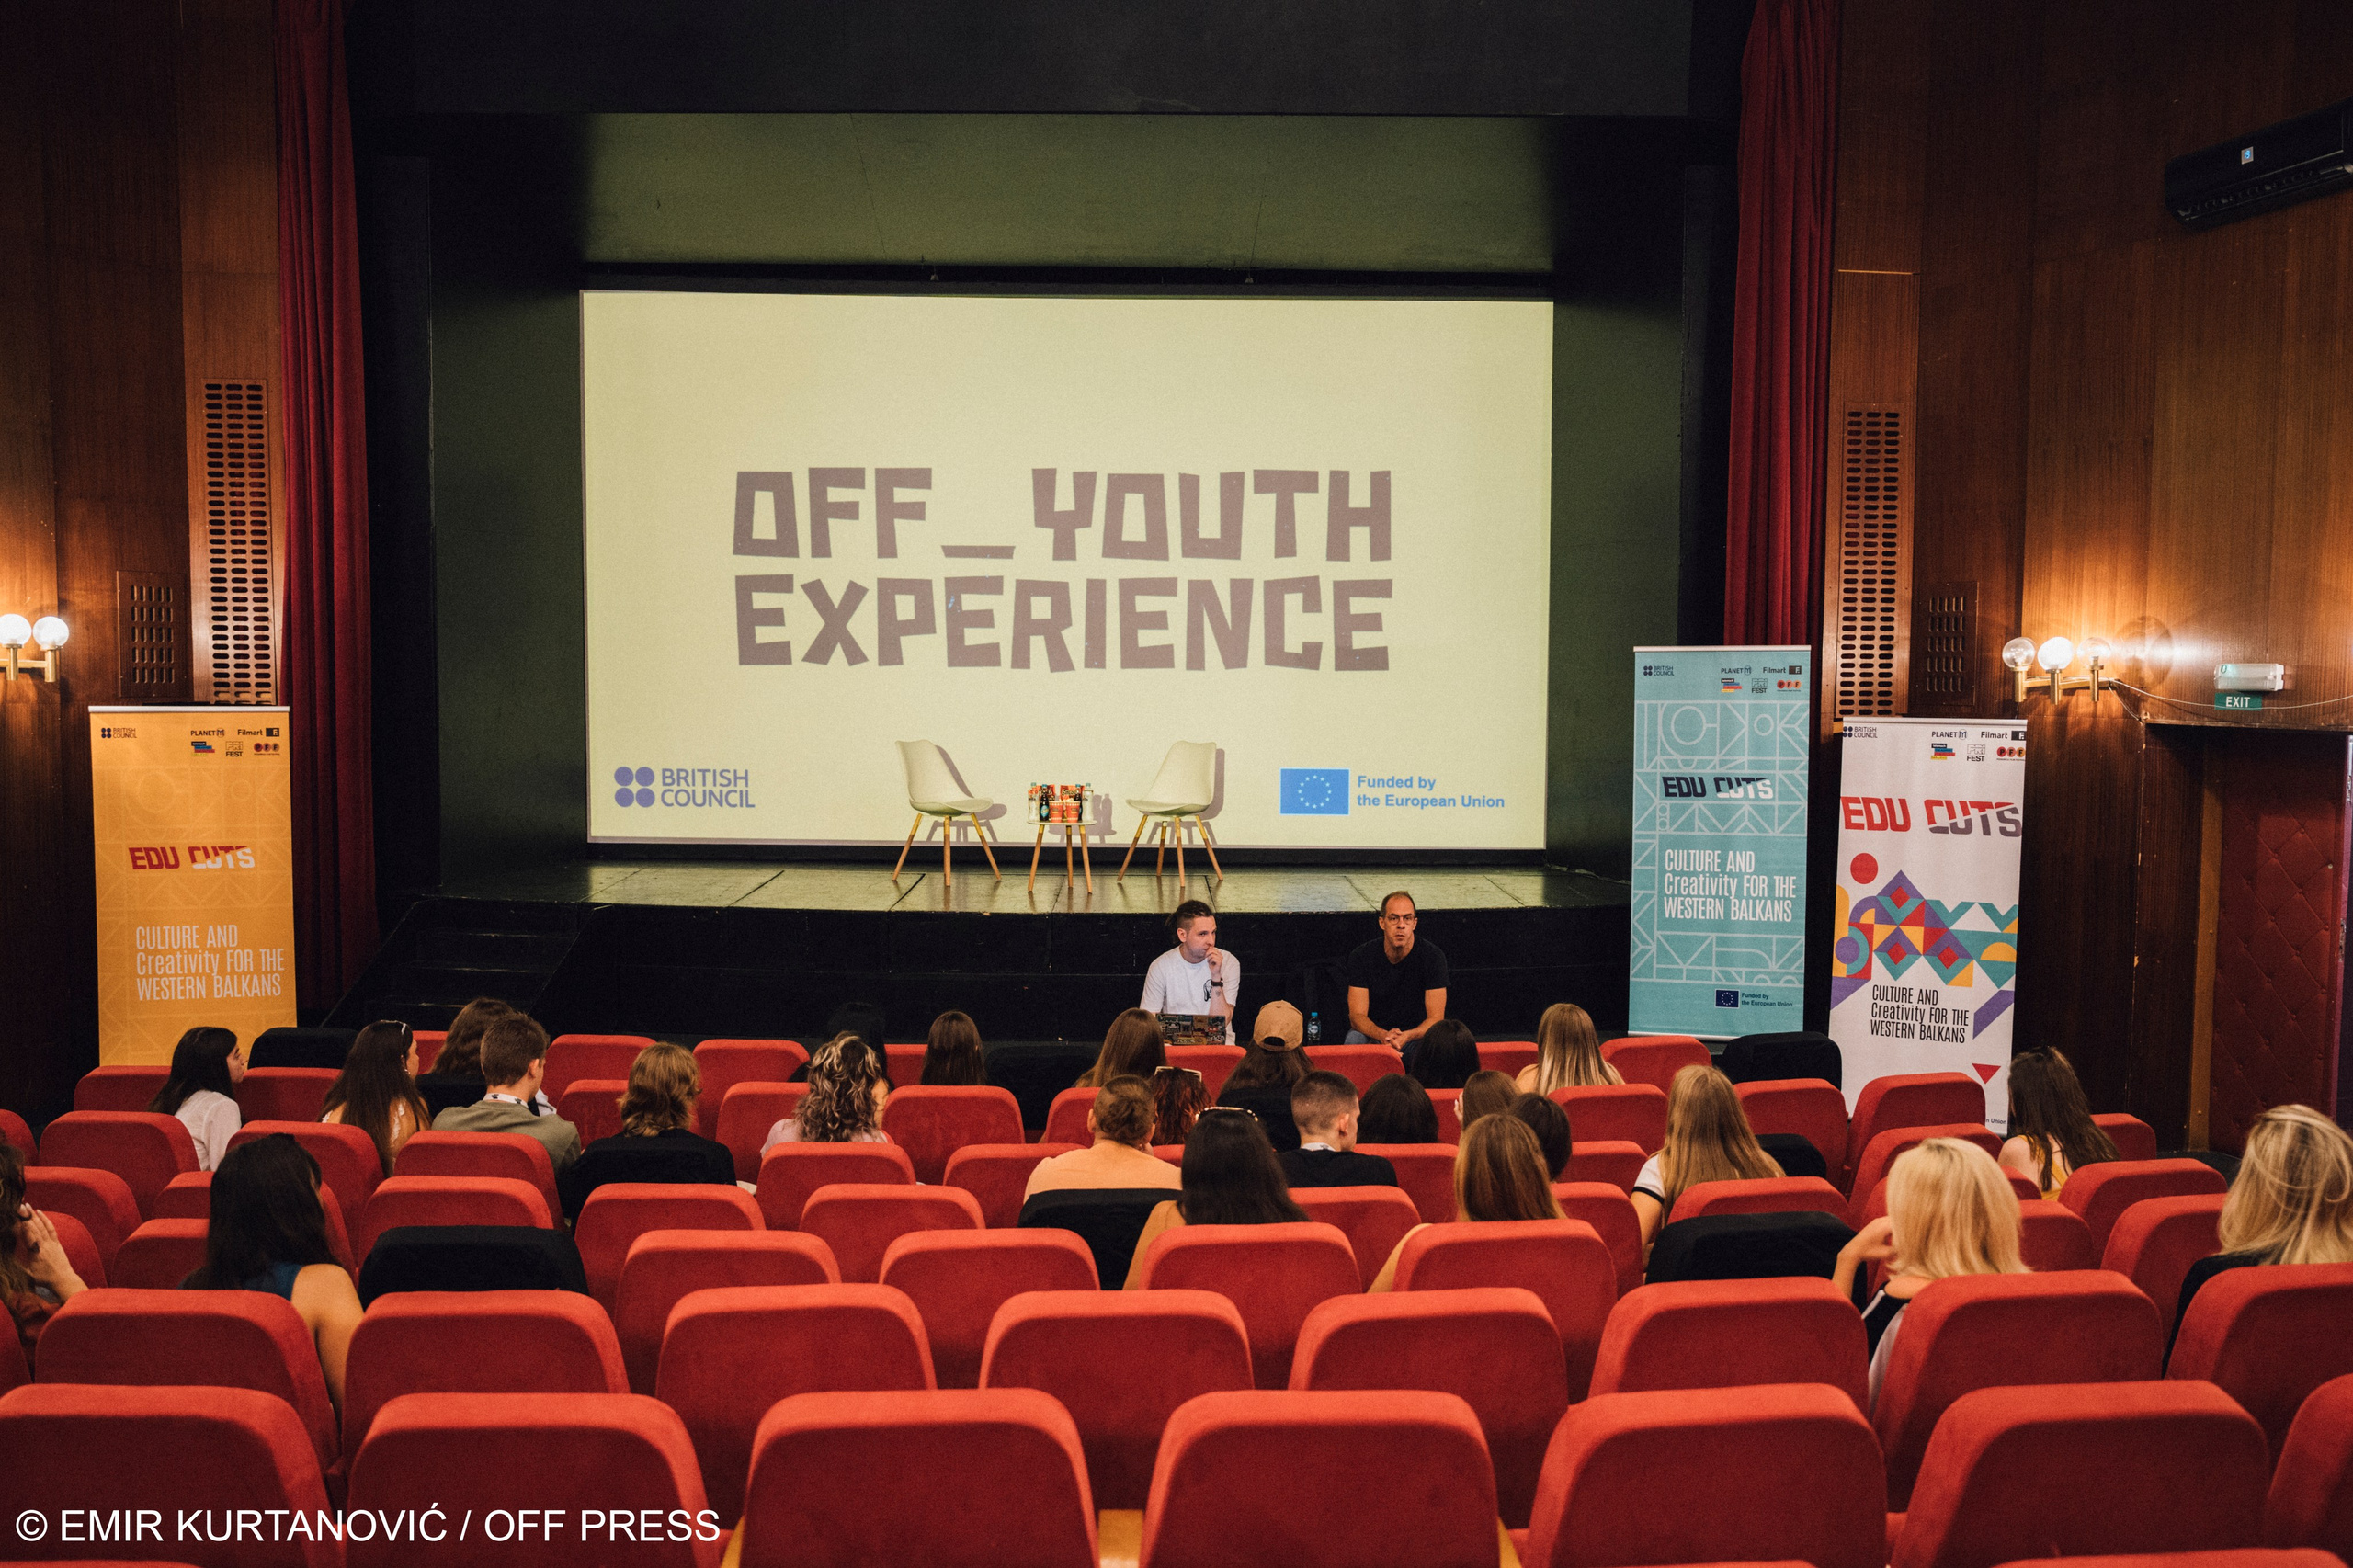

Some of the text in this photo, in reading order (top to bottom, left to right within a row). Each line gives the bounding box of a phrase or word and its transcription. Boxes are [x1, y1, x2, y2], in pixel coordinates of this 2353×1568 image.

[735, 574, 1392, 673] EXPERIENCE
[2225, 696, 2251, 708] EXIT
[1981, 731, 2007, 739] Filmart
[661, 768, 749, 788] BRITISH
[1358, 775, 1437, 791] Funded by
[1662, 776, 1774, 799] EDU CUTS
[661, 789, 756, 808] COUNCIL
[1357, 794, 1505, 810] the European Union
[1840, 796, 2022, 837] EDU CUTS
[128, 846, 256, 870] EDU CUTS
[1665, 849, 1756, 873] CULTURE AND
[1665, 873, 1797, 899] Creativity FOR THE
[1664, 896, 1792, 923] WESTERN BALKANS
[136, 924, 238, 950] CULTURE AND
[136, 948, 285, 977] Creativity FOR THE
[137, 973, 282, 1001] WESTERN BALKANS
[1872, 984, 1938, 1006] CULTURE AND
[1871, 1002, 1969, 1027] Creativity FOR THE
[1870, 1019, 1966, 1044] WESTERN BALKANS
